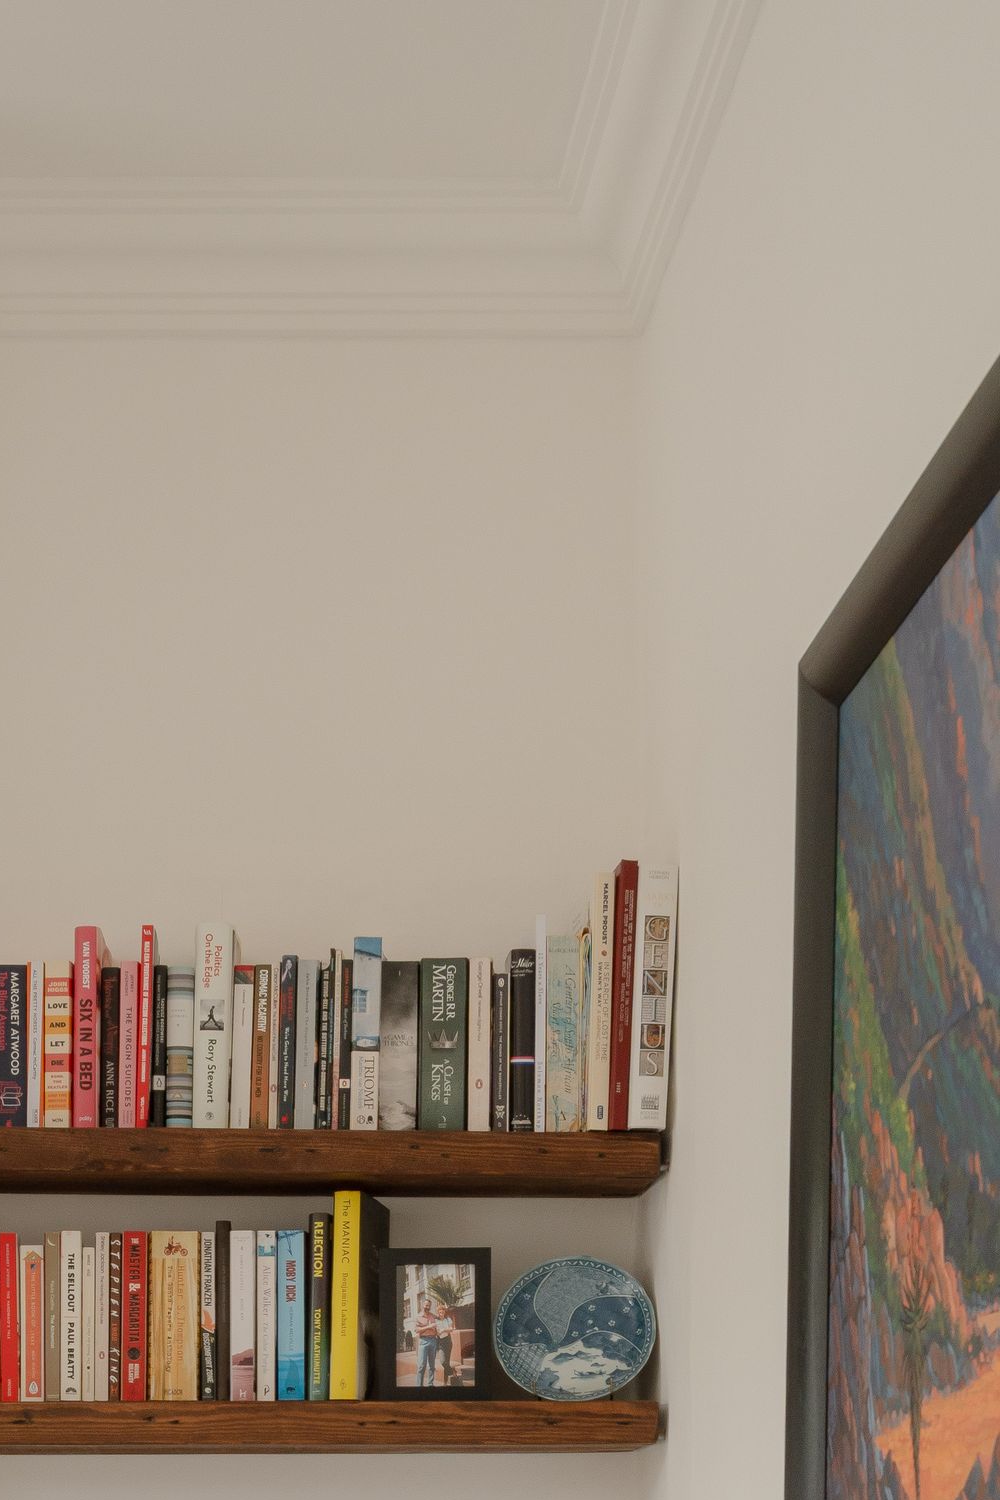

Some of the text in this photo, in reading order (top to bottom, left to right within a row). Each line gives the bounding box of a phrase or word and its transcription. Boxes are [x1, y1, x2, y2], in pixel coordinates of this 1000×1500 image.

[82, 941, 90, 990] VAN VOORST
[205, 934, 213, 947] On
[214, 945, 223, 976] Politics
[0, 990, 7, 1012] Blind
[203, 966, 212, 988] Edge
[257, 969, 268, 1032] CORMAC McCARTHY
[432, 964, 446, 1022] MARTIN
[602, 969, 610, 1004] SEARCH
[639, 915, 671, 1077] GENIUS
[0, 1014, 7, 1051] Assassin
[10, 972, 20, 1075] MARGARET ATWOOD
[551, 1002, 561, 1025] Short
[602, 1007, 609, 1017] OF
[79, 998, 92, 1090] SIX IN A BED
[105, 1060, 114, 1113] ANNE RICE
[205, 1039, 217, 1103] Rory Stewart
[365, 1056, 375, 1110] TRIOMF
[431, 1063, 443, 1101] KINGS
[443, 1066, 453, 1096] CLASH
[313, 1221, 323, 1278] REJECTION
[341, 1199, 351, 1264] The MANIAC
[110, 1239, 121, 1317] STEPHEN
[129, 1244, 140, 1342] MASTER & MARGARITA
[204, 1238, 213, 1307] JONATHAN FRANZEN
[263, 1265, 271, 1316] Alice Walker
[286, 1260, 296, 1302] MOBY DICK
[67, 1322, 75, 1379] PAUL BEATTY
[109, 1347, 120, 1383] KING
[203, 1332, 214, 1383] DISCOMFORT ZONE
[313, 1308, 321, 1384] TONY TULATHIMUTTE
